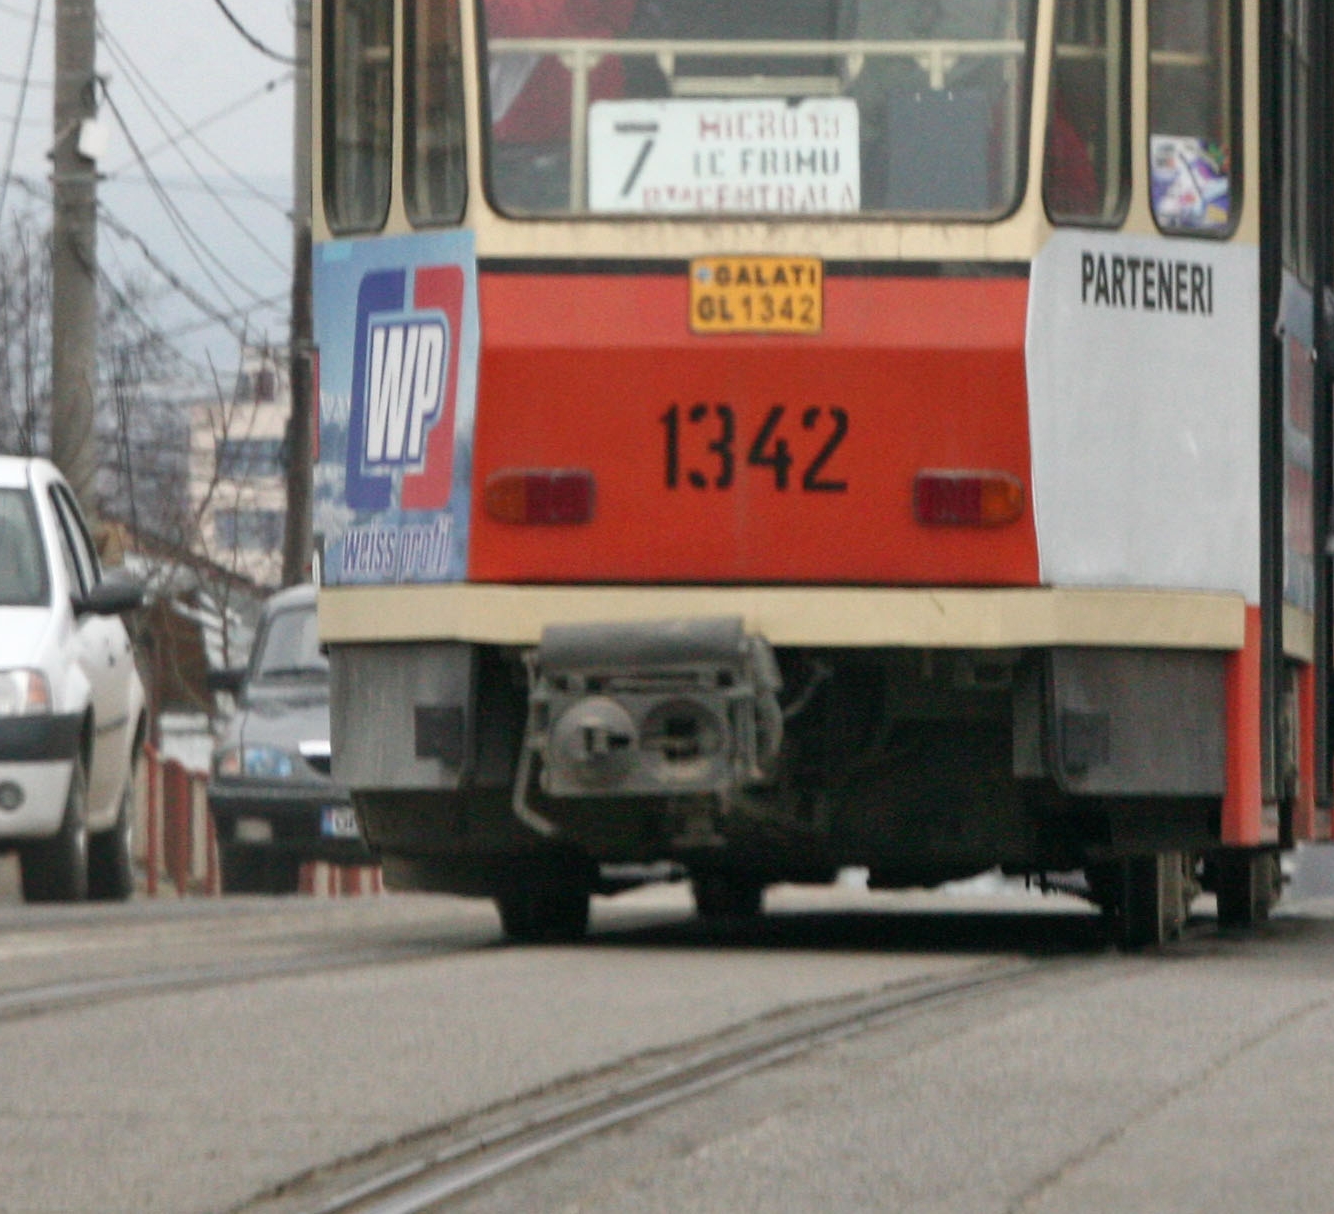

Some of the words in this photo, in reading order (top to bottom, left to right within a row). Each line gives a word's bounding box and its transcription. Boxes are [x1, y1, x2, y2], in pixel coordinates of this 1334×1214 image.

[698, 110, 799, 140] MICRO
[614, 121, 659, 198] 7
[740, 146, 840, 176] FRIMU
[716, 266, 817, 286] GALATI
[1081, 250, 1214, 315] PARTENERI
[365, 321, 446, 463] WP
[660, 402, 849, 492] 1342
[343, 518, 396, 574] weiss
